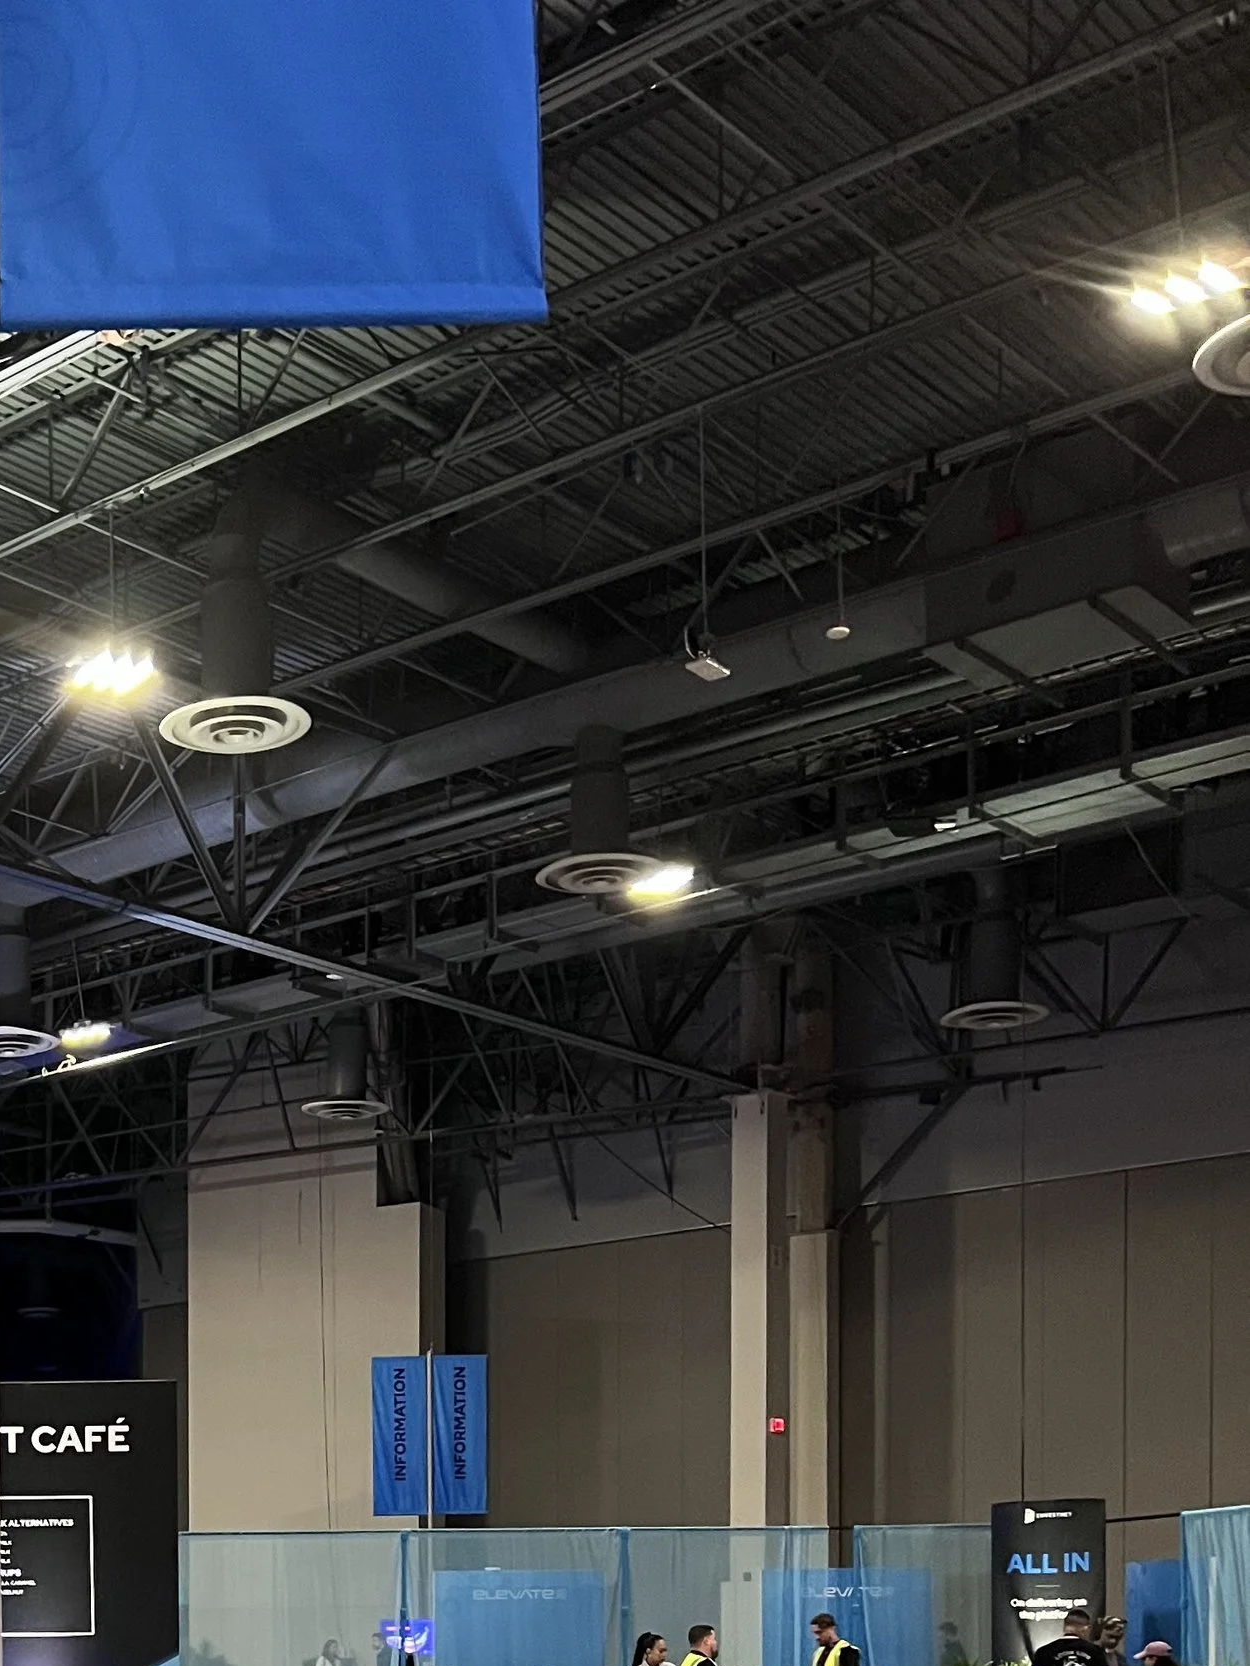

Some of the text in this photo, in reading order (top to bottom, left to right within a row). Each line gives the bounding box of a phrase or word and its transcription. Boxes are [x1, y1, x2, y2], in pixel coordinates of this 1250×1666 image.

[31, 1417, 130, 1453] CAFÉ
[393, 1368, 407, 1481] INFORMATION
[453, 1366, 467, 1480] INFORMATION
[1006, 1551, 1090, 1574] ALL IN
